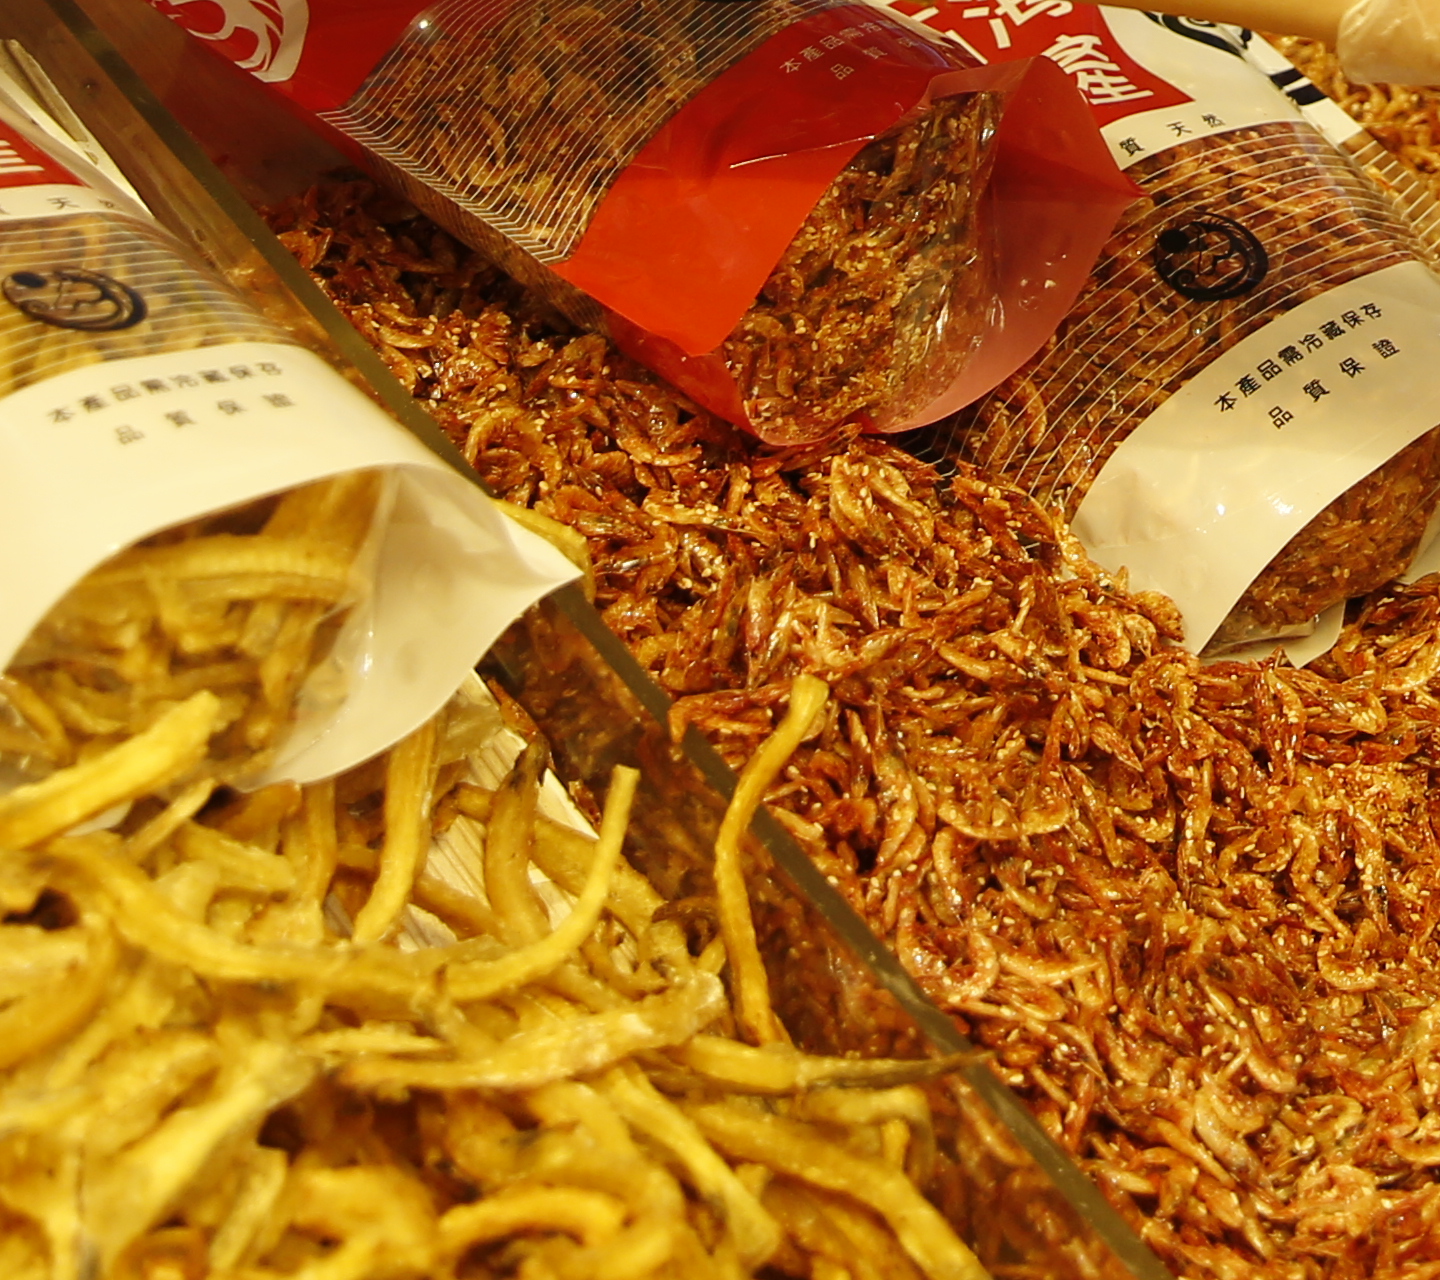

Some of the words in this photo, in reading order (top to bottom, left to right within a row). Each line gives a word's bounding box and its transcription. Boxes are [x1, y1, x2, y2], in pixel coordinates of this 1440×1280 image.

[1213, 302, 1383, 413] 本產品需冷藏保存
[1267, 338, 1401, 430] 品質保證
